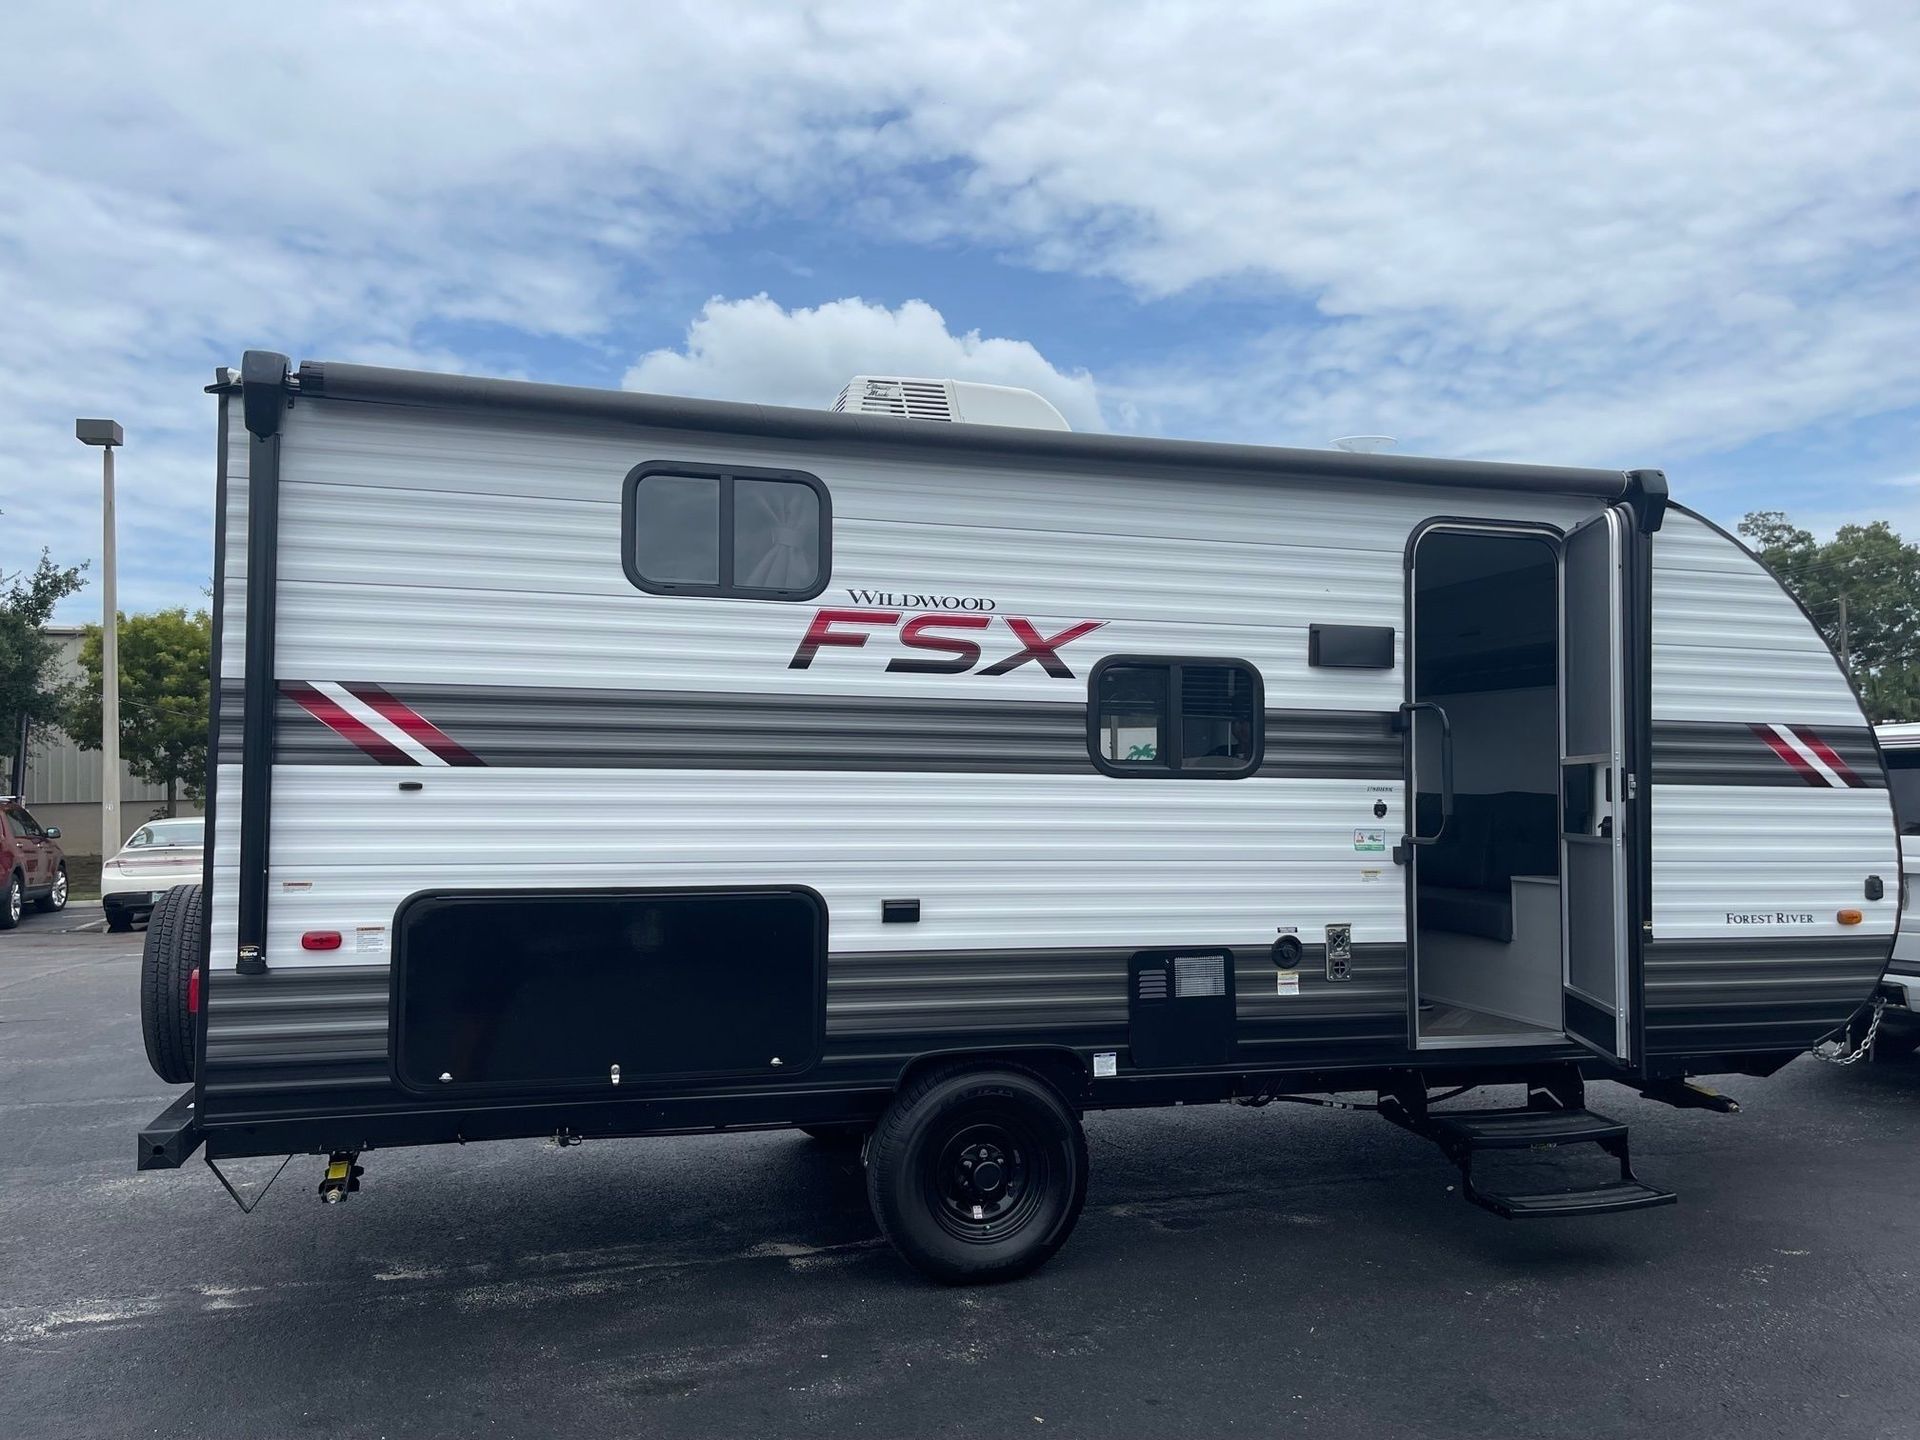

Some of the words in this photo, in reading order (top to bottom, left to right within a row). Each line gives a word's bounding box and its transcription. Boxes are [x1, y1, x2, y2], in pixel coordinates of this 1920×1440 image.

[846, 589, 996, 611] WILDWOOD
[788, 608, 1111, 679] FSX
[1726, 912, 1773, 924] FOREST
[1776, 912, 1814, 924] RIVER
